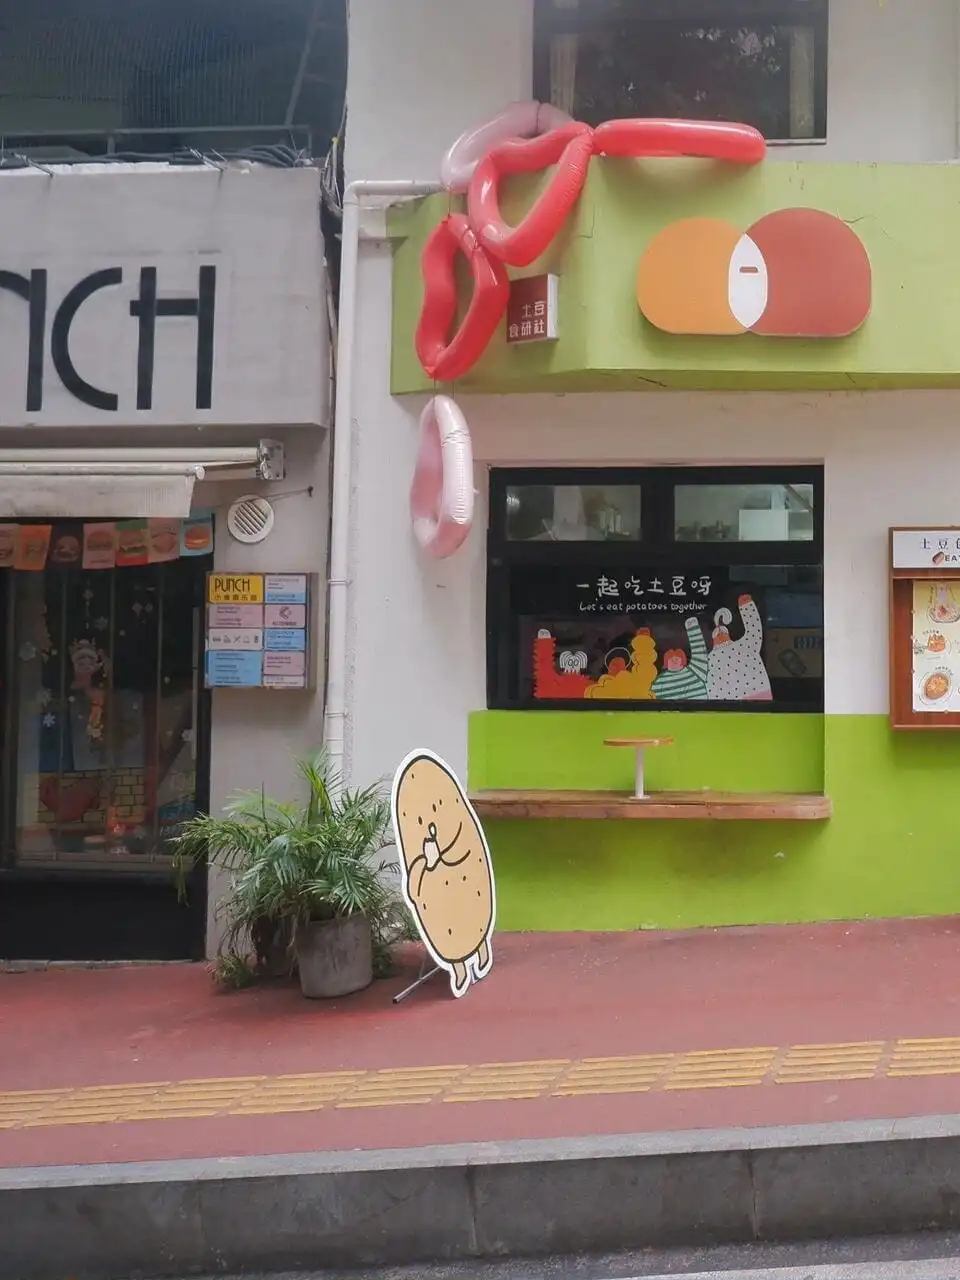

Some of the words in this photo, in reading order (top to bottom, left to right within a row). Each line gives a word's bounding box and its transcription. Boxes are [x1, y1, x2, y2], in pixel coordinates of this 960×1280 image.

[577, 575, 712, 597] 一起吃土豆呀
[579, 597, 605, 611] Let's
[606, 602, 623, 611] eat
[626, 602, 667, 613] potatoes
[670, 601, 707, 613] together
